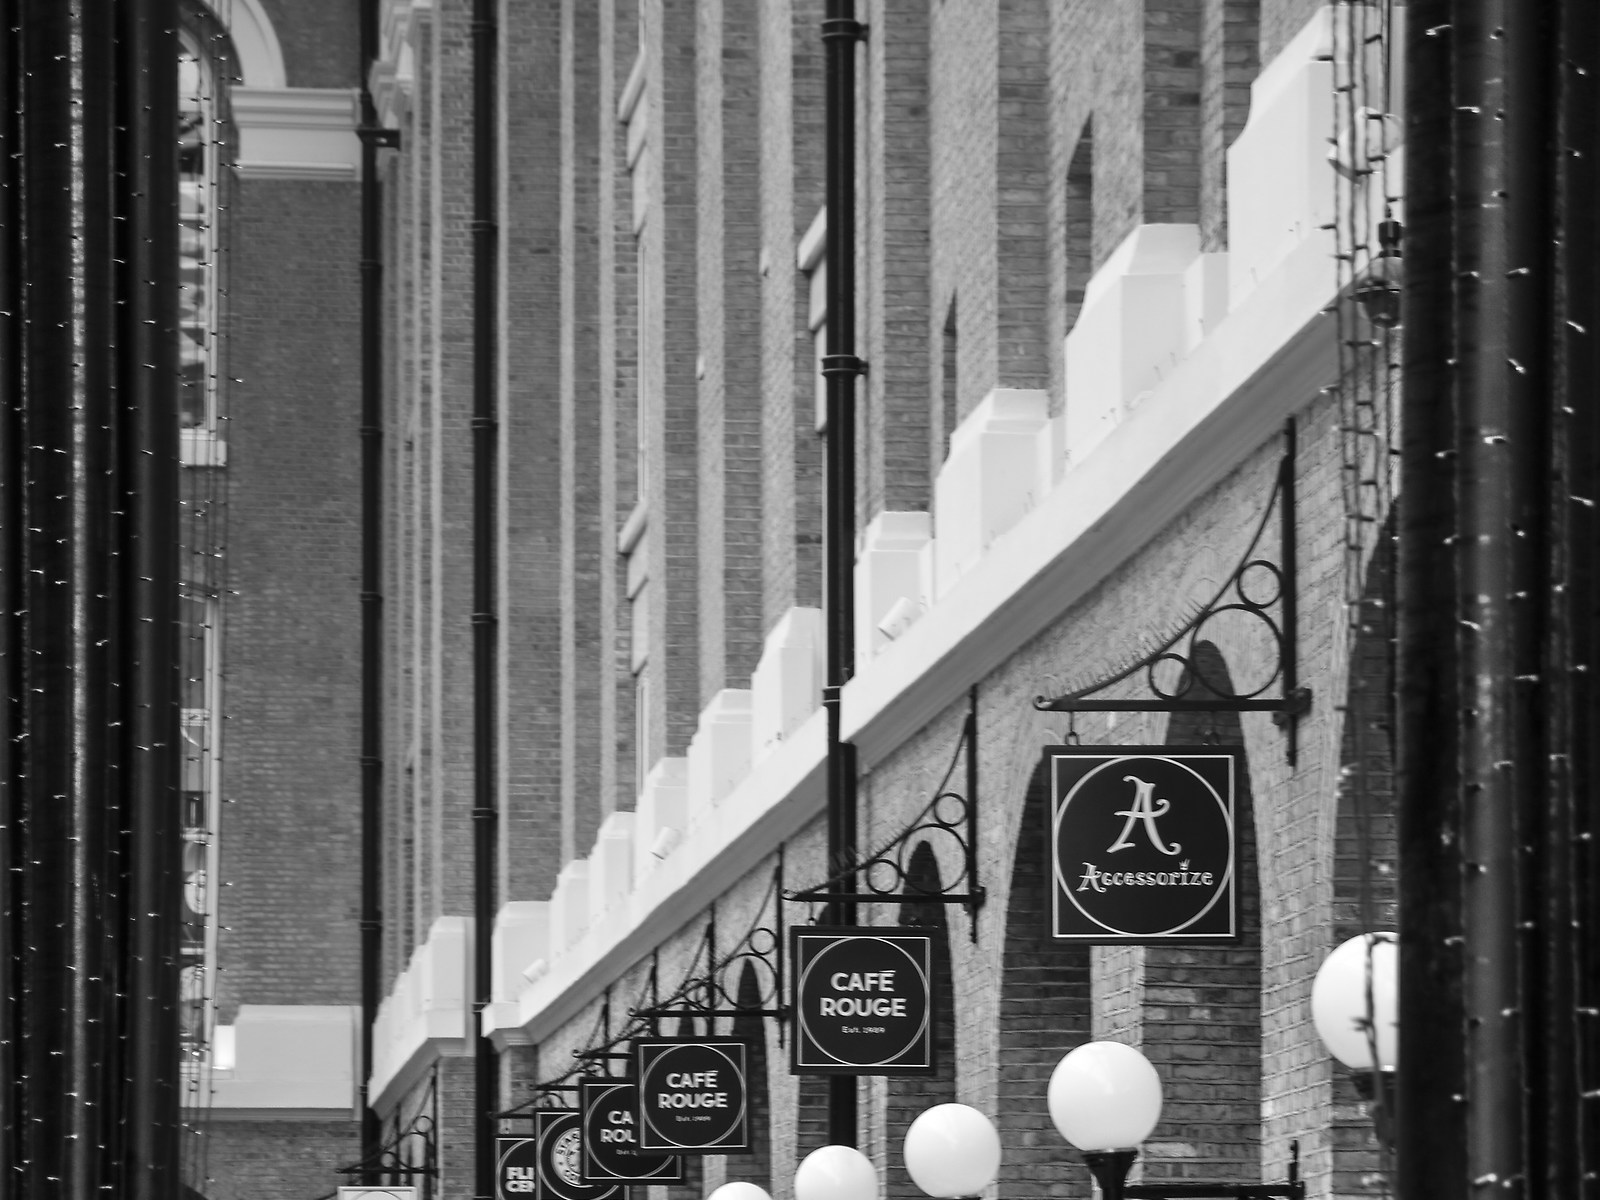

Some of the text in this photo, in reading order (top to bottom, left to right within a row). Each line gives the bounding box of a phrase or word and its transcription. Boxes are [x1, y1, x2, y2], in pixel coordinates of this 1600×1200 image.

[1106, 775, 1182, 856] A
[1076, 860, 1214, 893] Accessorize
[820, 997, 907, 1017] ROUGE
[657, 1092, 729, 1109] ROUGE
[607, 1110, 634, 1125] CA
